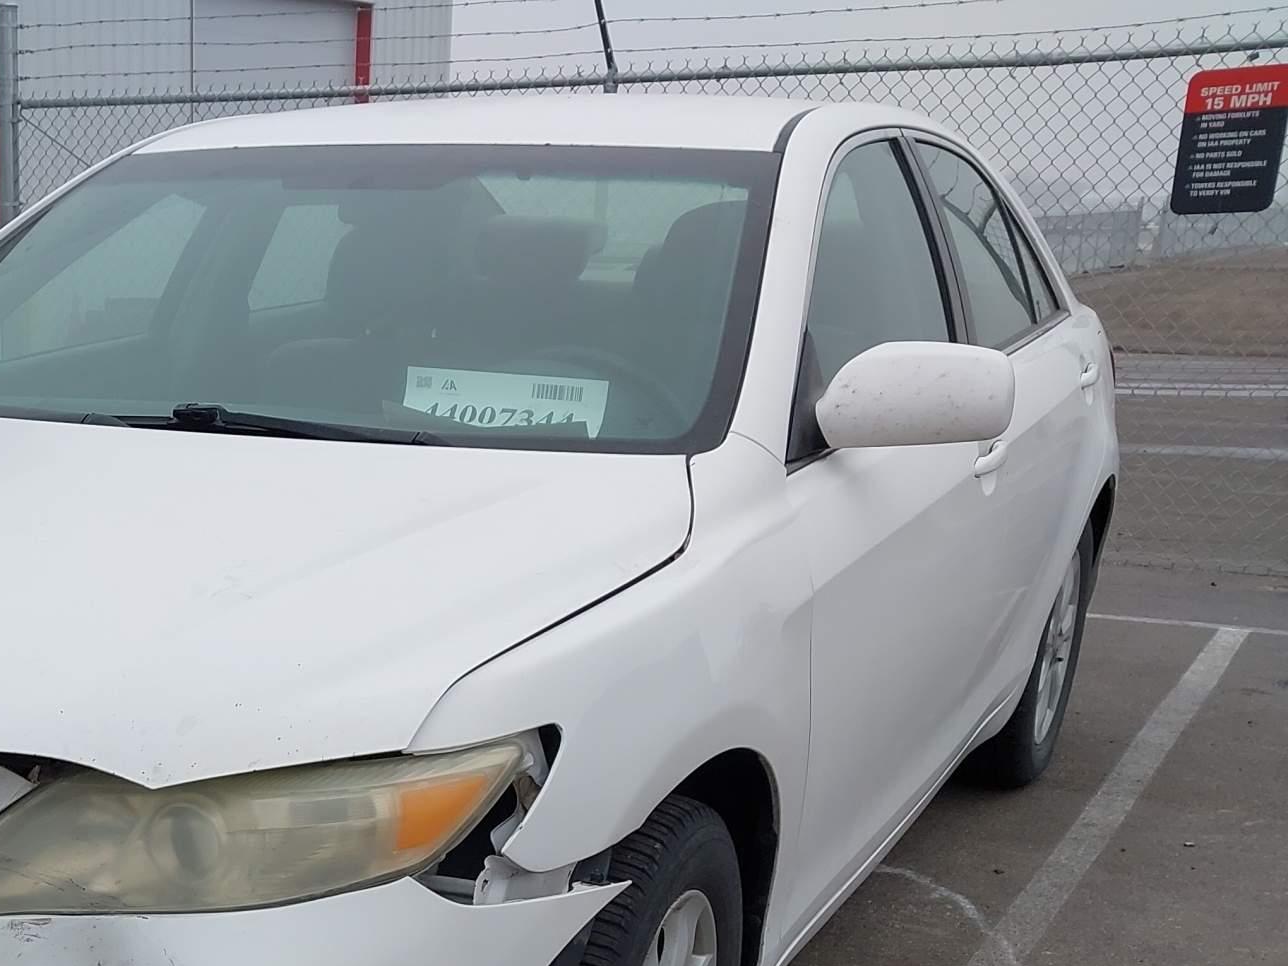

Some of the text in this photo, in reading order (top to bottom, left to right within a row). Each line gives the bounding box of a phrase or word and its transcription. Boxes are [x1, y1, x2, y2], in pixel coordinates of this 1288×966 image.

[1200, 81, 1280, 97] SPEED LIMIT
[1205, 93, 1273, 110] 15 MPH
[1209, 131, 1238, 139] WORKING
[1239, 130, 1249, 138] ON
[1249, 129, 1266, 137] CARS
[1219, 138, 1252, 146] PROPERTY
[1226, 159, 1268, 169] RESPONSIBLE
[1204, 169, 1231, 177] DAMAGE
[1216, 179, 1257, 188] RESPONSIBLE
[1219, 188, 1231, 196] VIN
